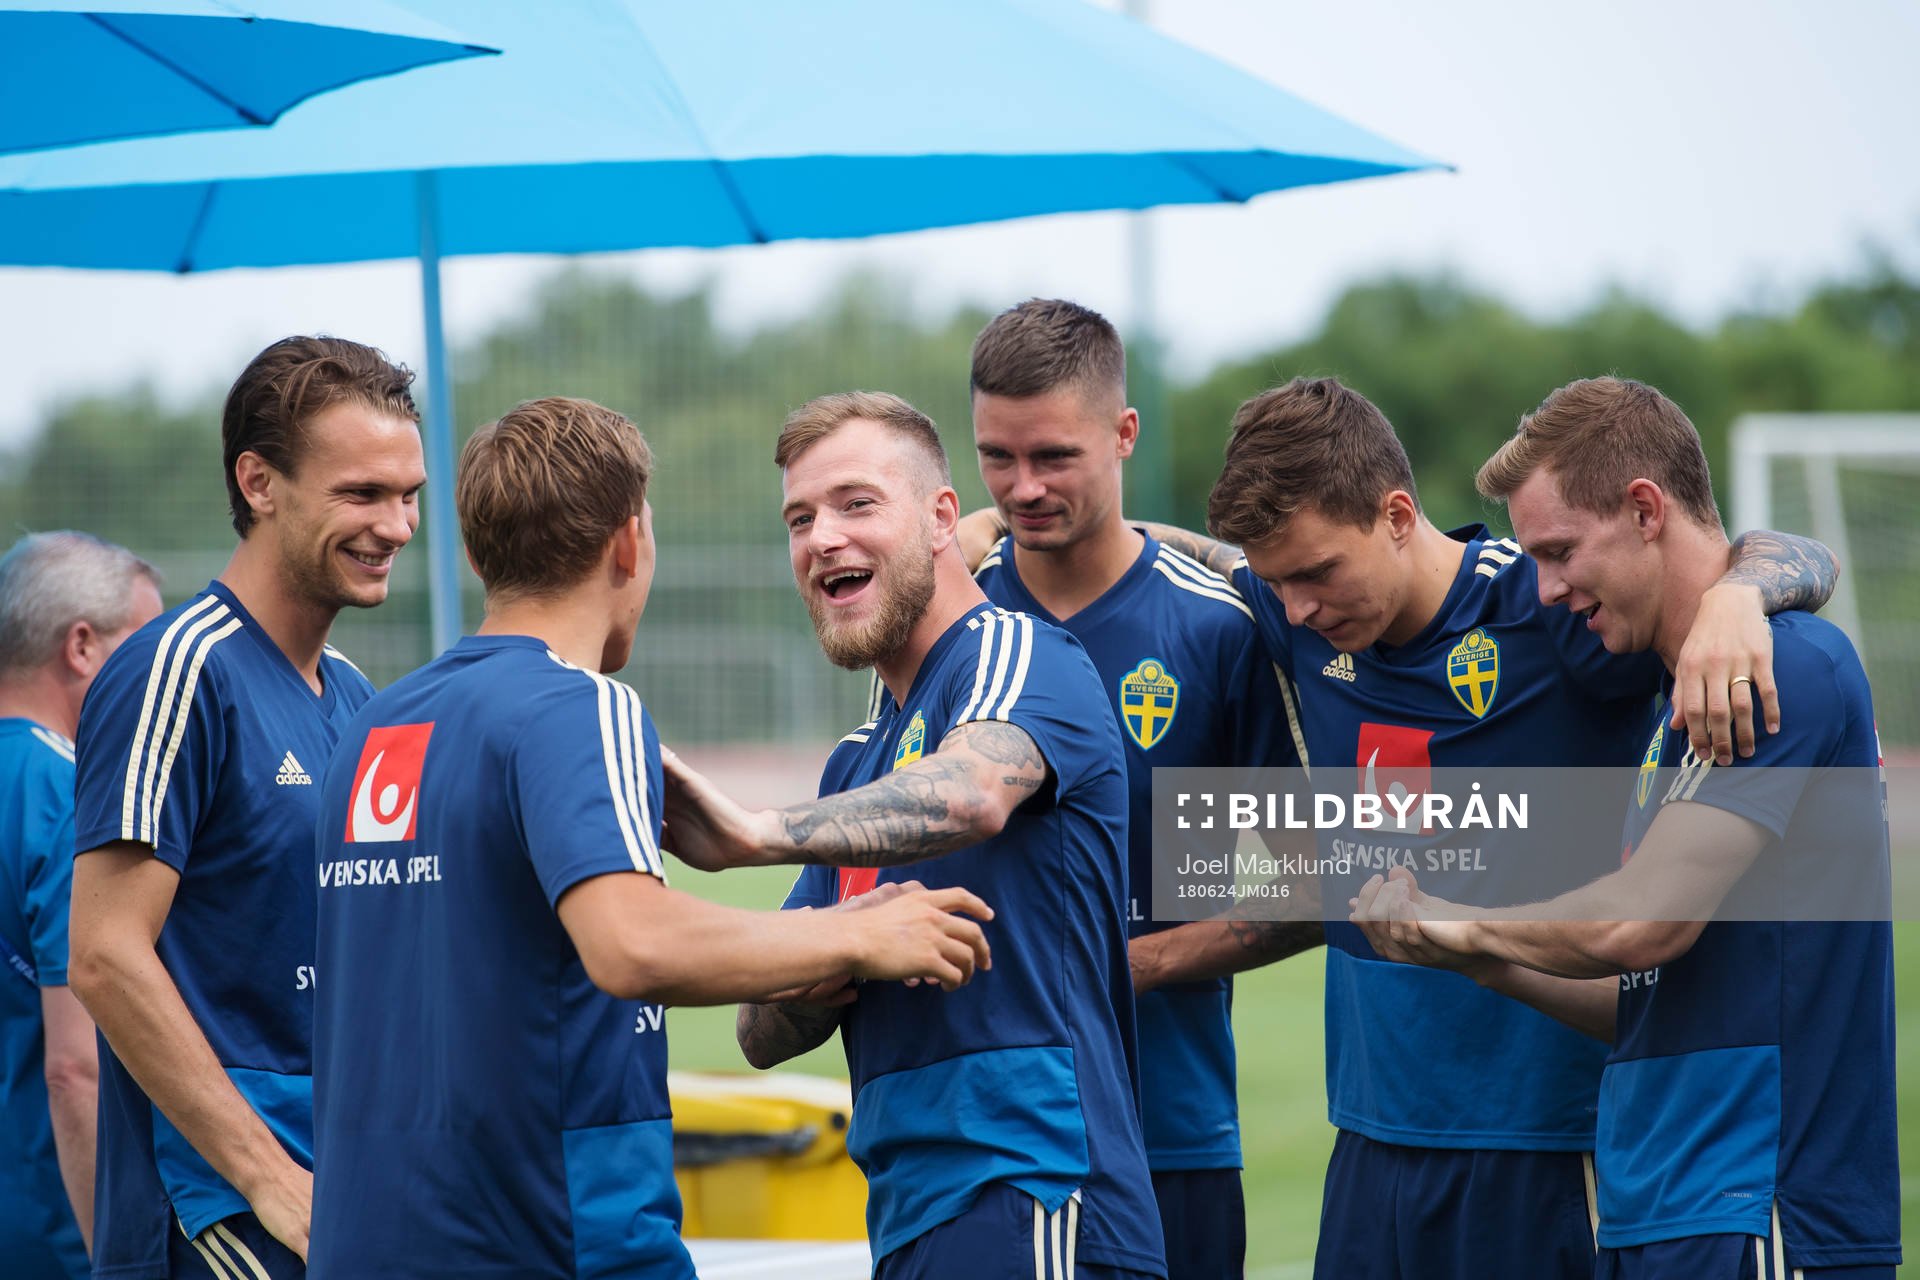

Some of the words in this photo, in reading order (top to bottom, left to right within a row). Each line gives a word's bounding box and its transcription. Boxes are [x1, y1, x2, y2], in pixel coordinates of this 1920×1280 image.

[1456, 651, 1490, 663] SVERIGE
[1322, 665, 1357, 682] adidas
[1130, 685, 1169, 695] SVERIGE
[275, 772, 312, 785] adidas
[1424, 848, 1487, 872] SPEL
[406, 855, 442, 883] SPEL
